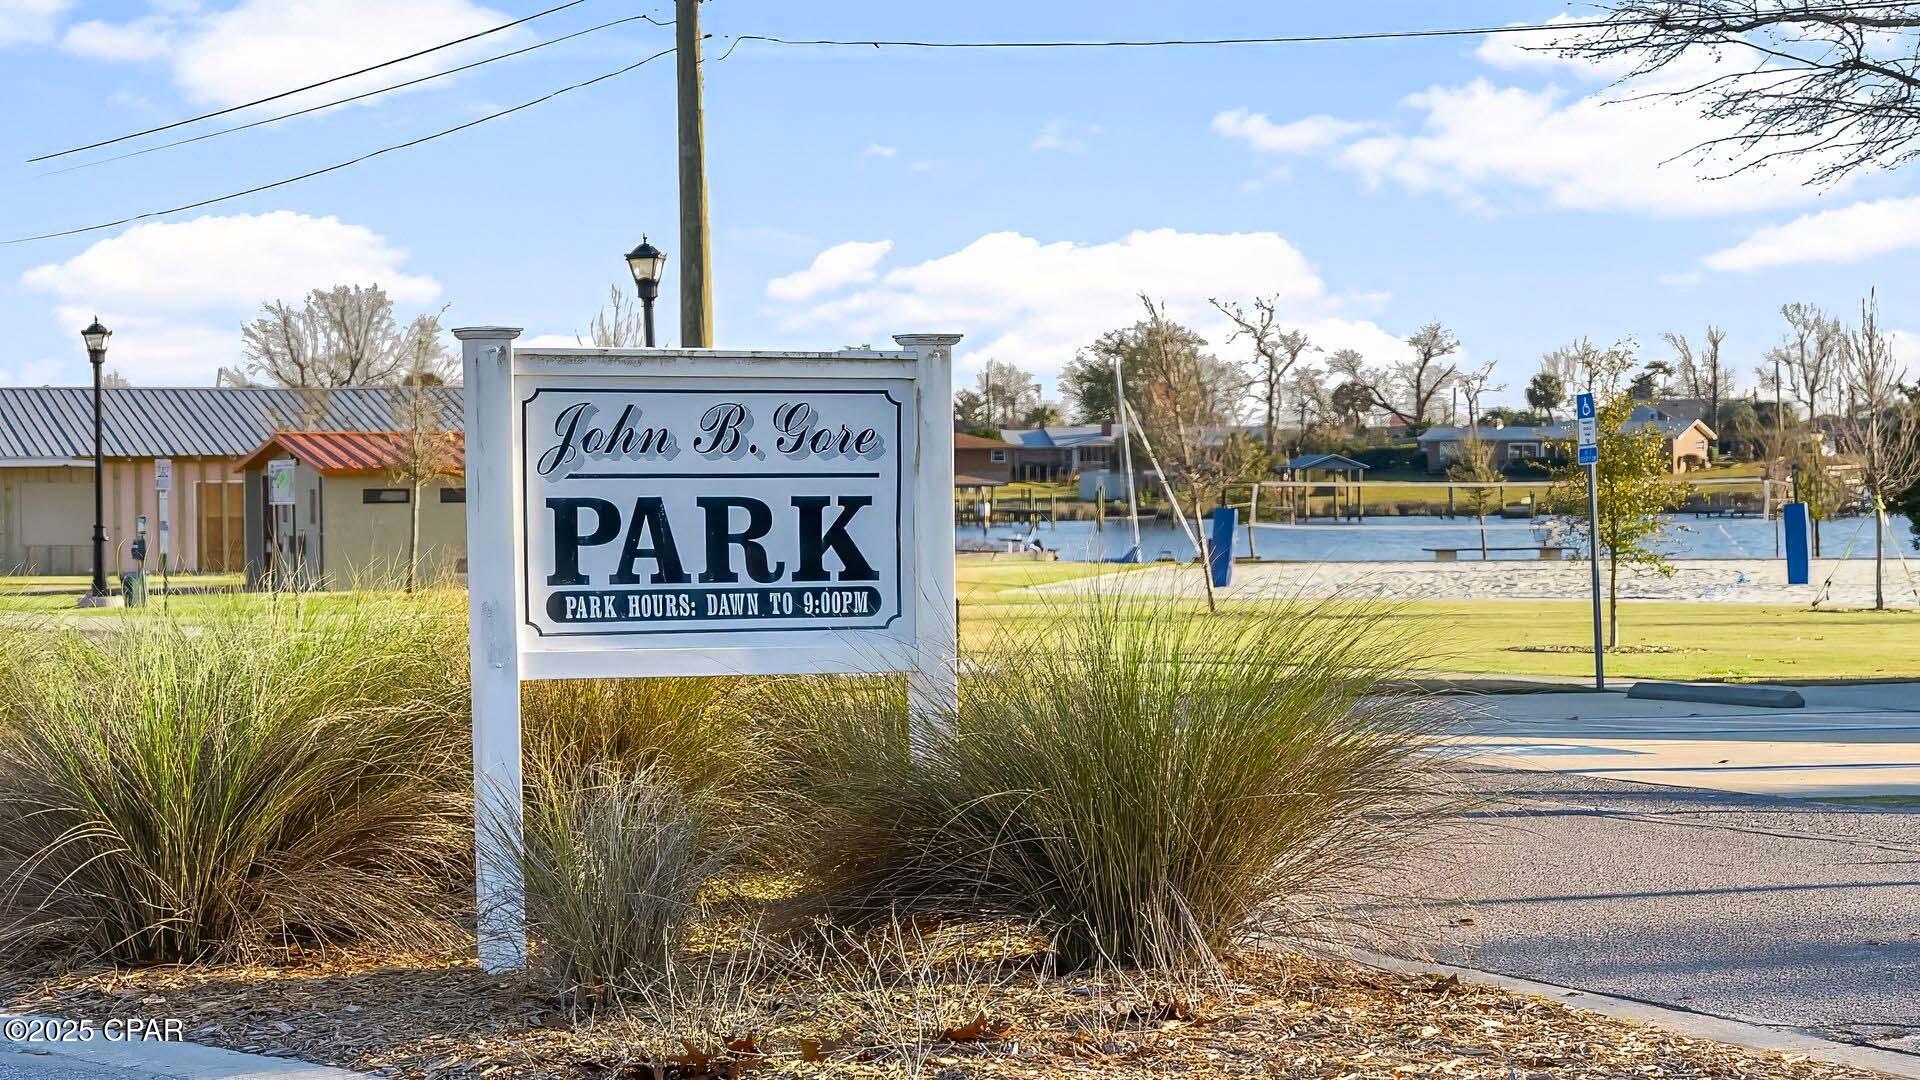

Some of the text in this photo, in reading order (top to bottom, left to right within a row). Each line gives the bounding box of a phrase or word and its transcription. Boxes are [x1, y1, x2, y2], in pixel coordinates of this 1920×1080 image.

[536, 401, 880, 476] John B. Gore
[545, 495, 880, 586] PARK
[564, 590, 870, 619] PARK HOURS: DAWN TO 9:00PM
